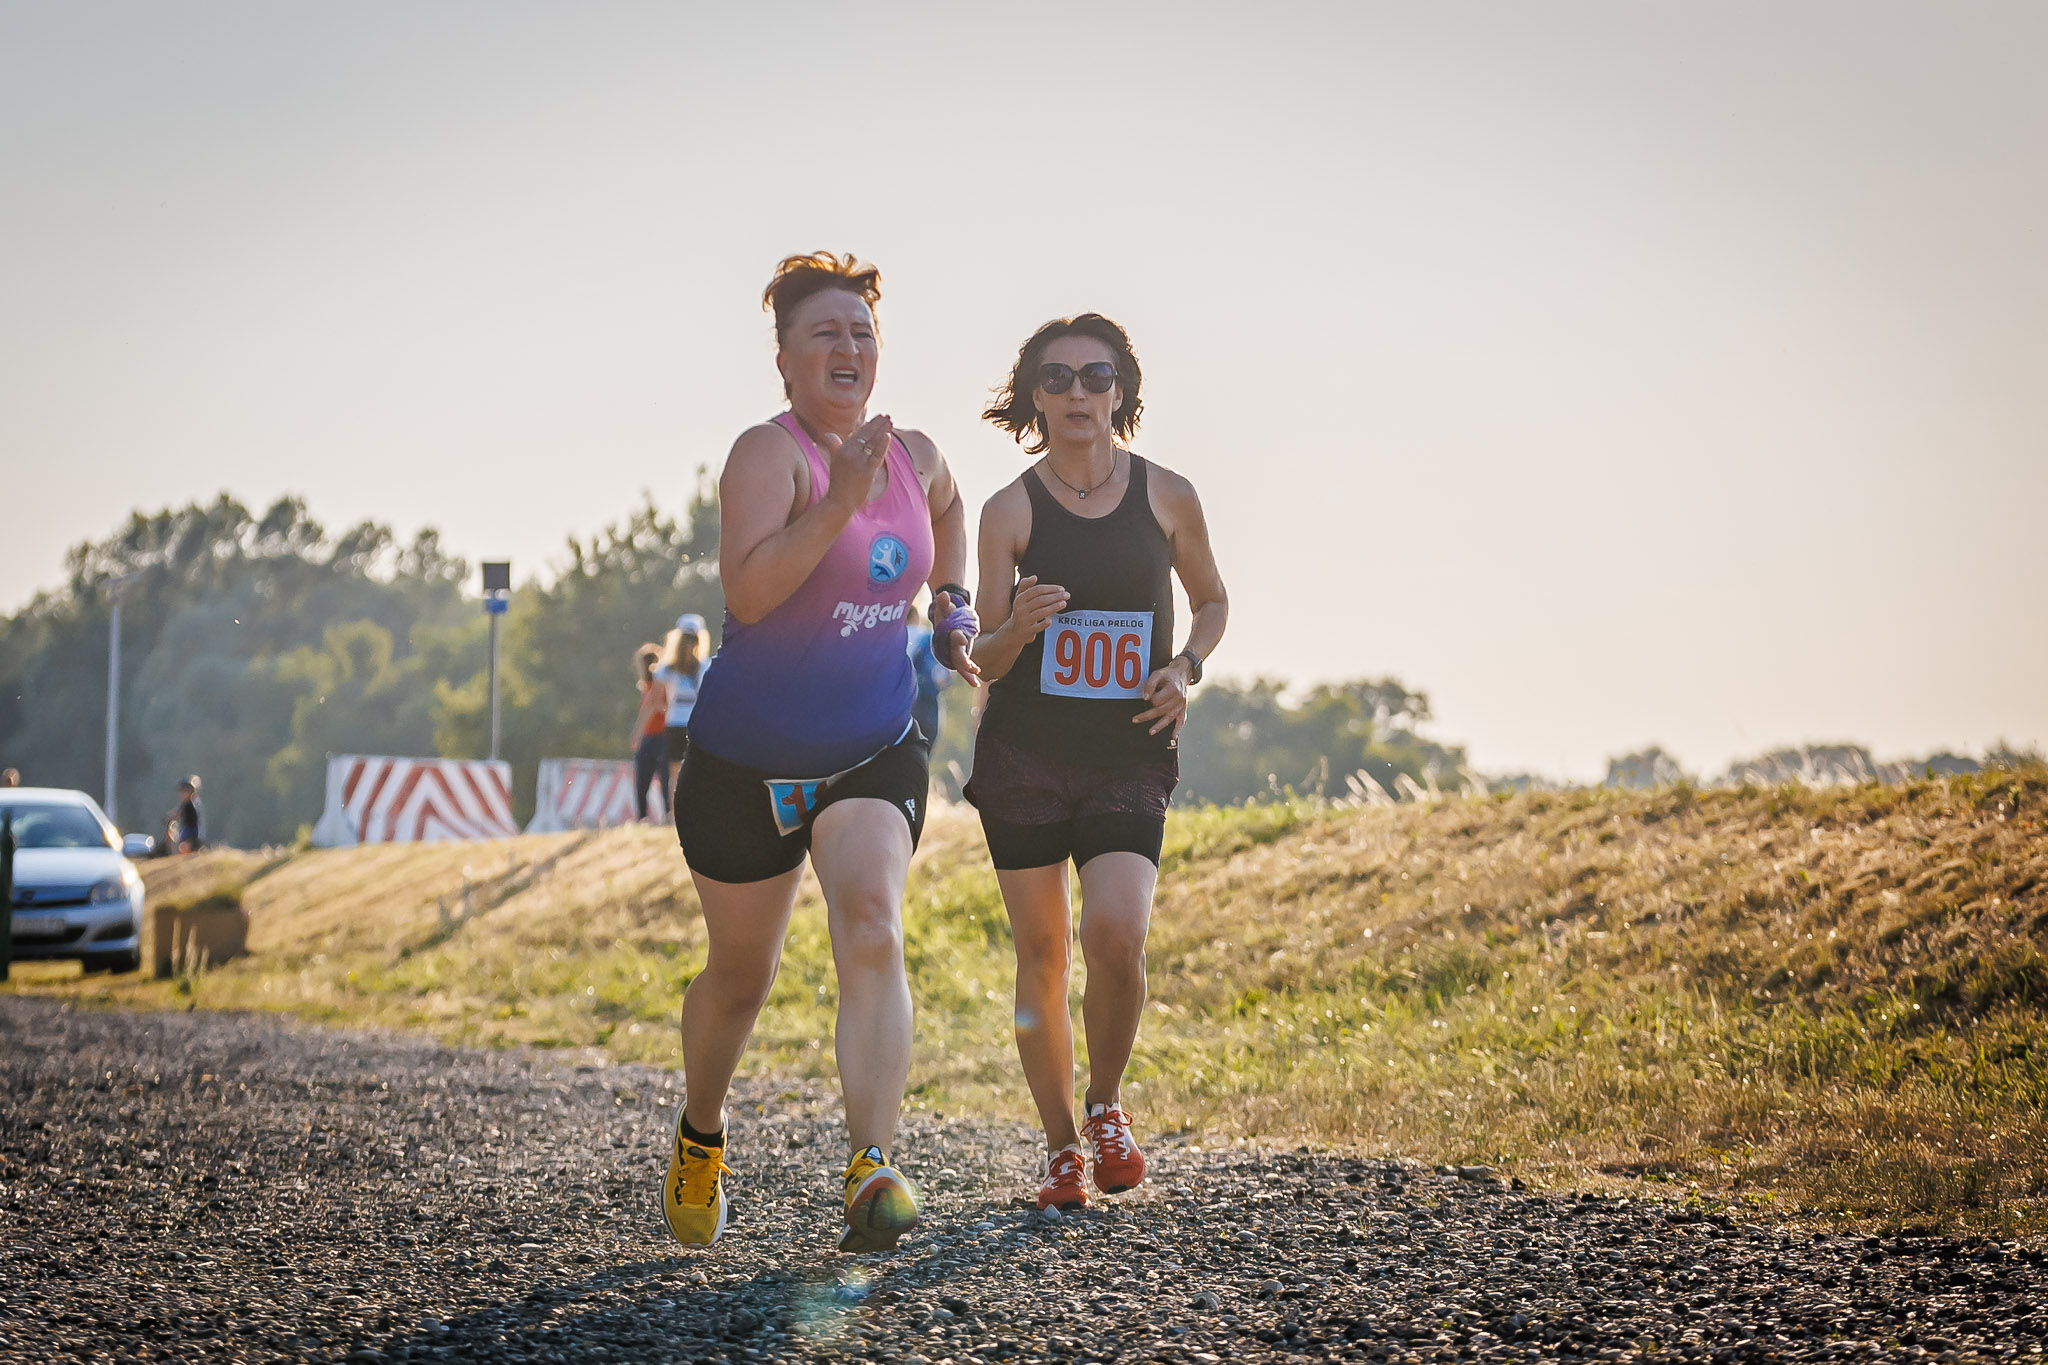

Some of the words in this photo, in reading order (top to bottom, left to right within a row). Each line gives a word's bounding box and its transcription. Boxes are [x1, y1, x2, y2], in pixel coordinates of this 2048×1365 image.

[1058, 617, 1082, 627] KROS
[1084, 619, 1105, 627] LIGA
[1108, 619, 1144, 628] PRELOG
[1054, 629, 1142, 689] 906
